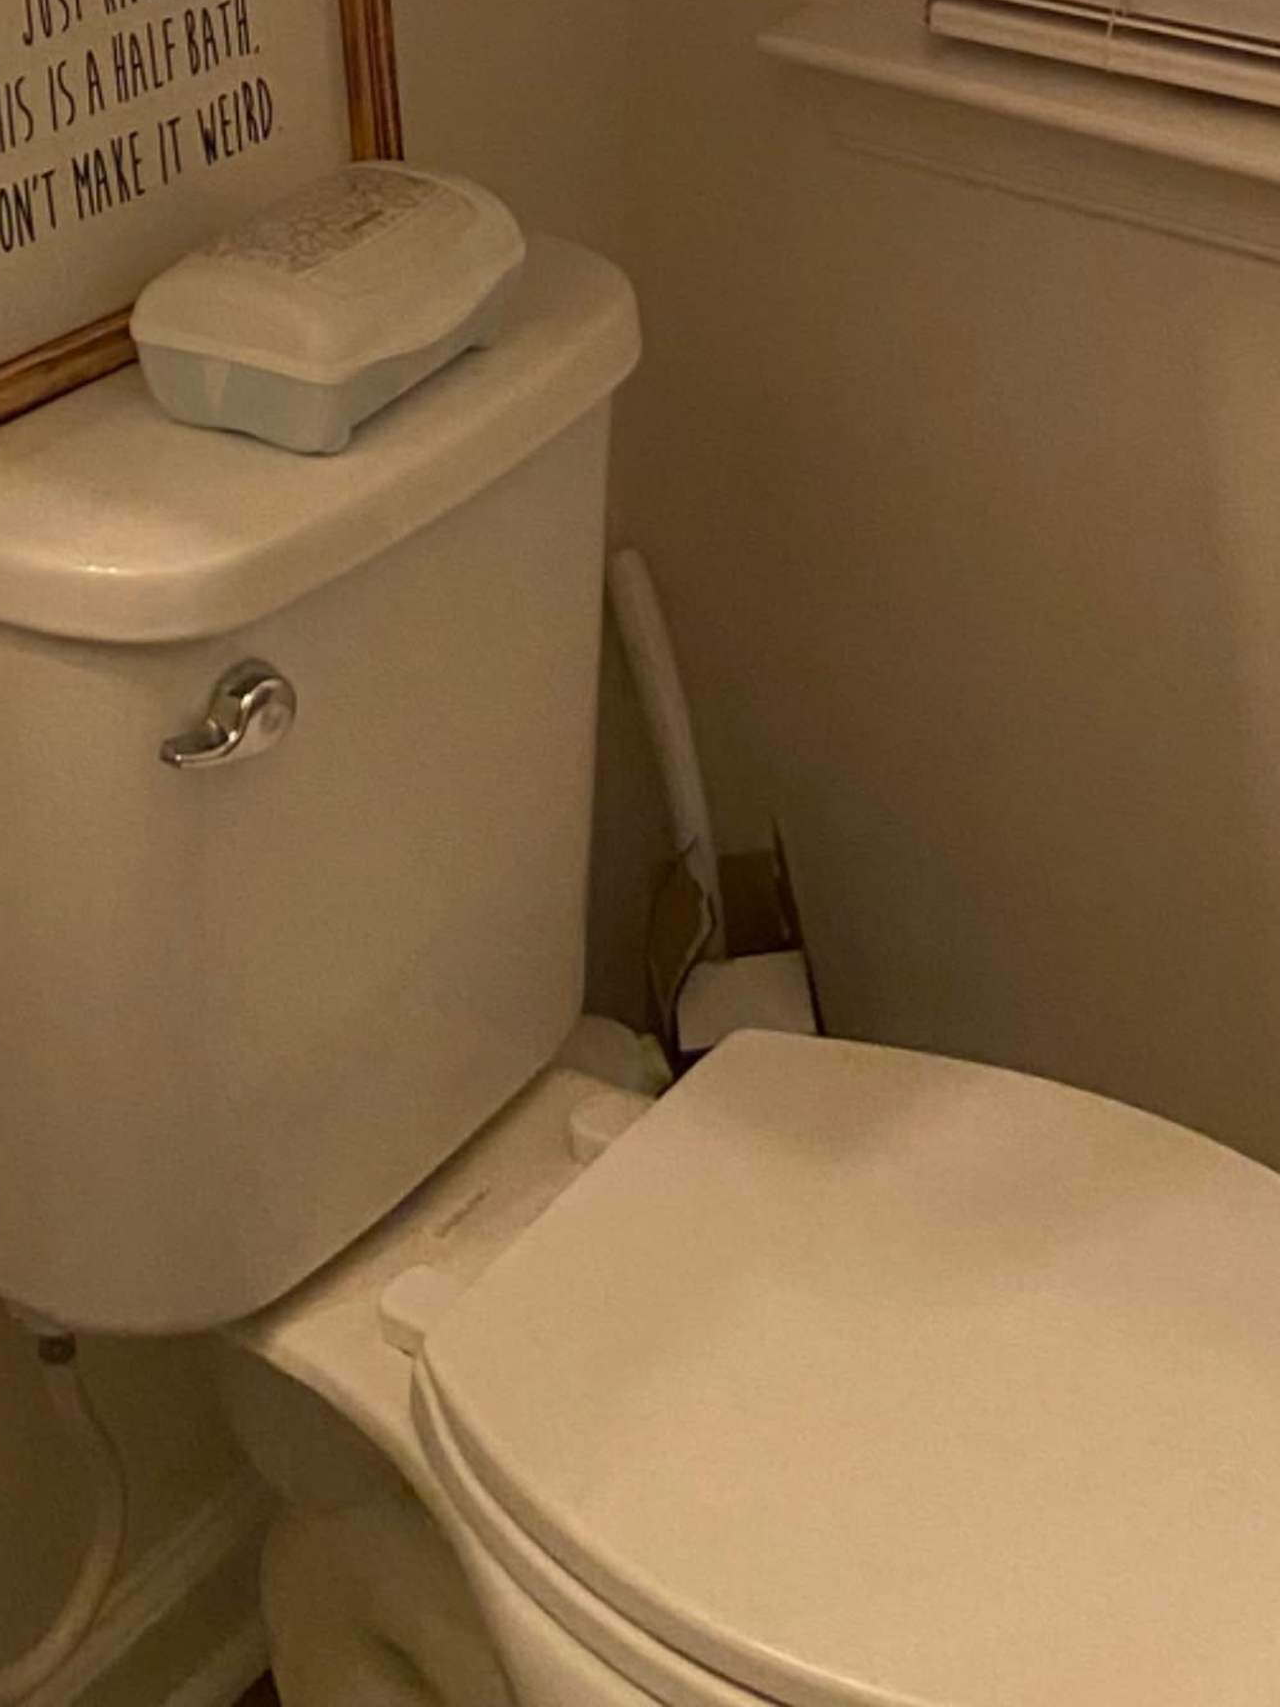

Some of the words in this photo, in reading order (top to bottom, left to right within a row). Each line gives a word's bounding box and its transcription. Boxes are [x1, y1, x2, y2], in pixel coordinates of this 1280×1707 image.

[46, 58, 76, 133] IS
[85, 49, 107, 116] A
[110, 15, 176, 104] HALF
[70, 130, 147, 221] MAKE
[157, 114, 183, 186] IT
